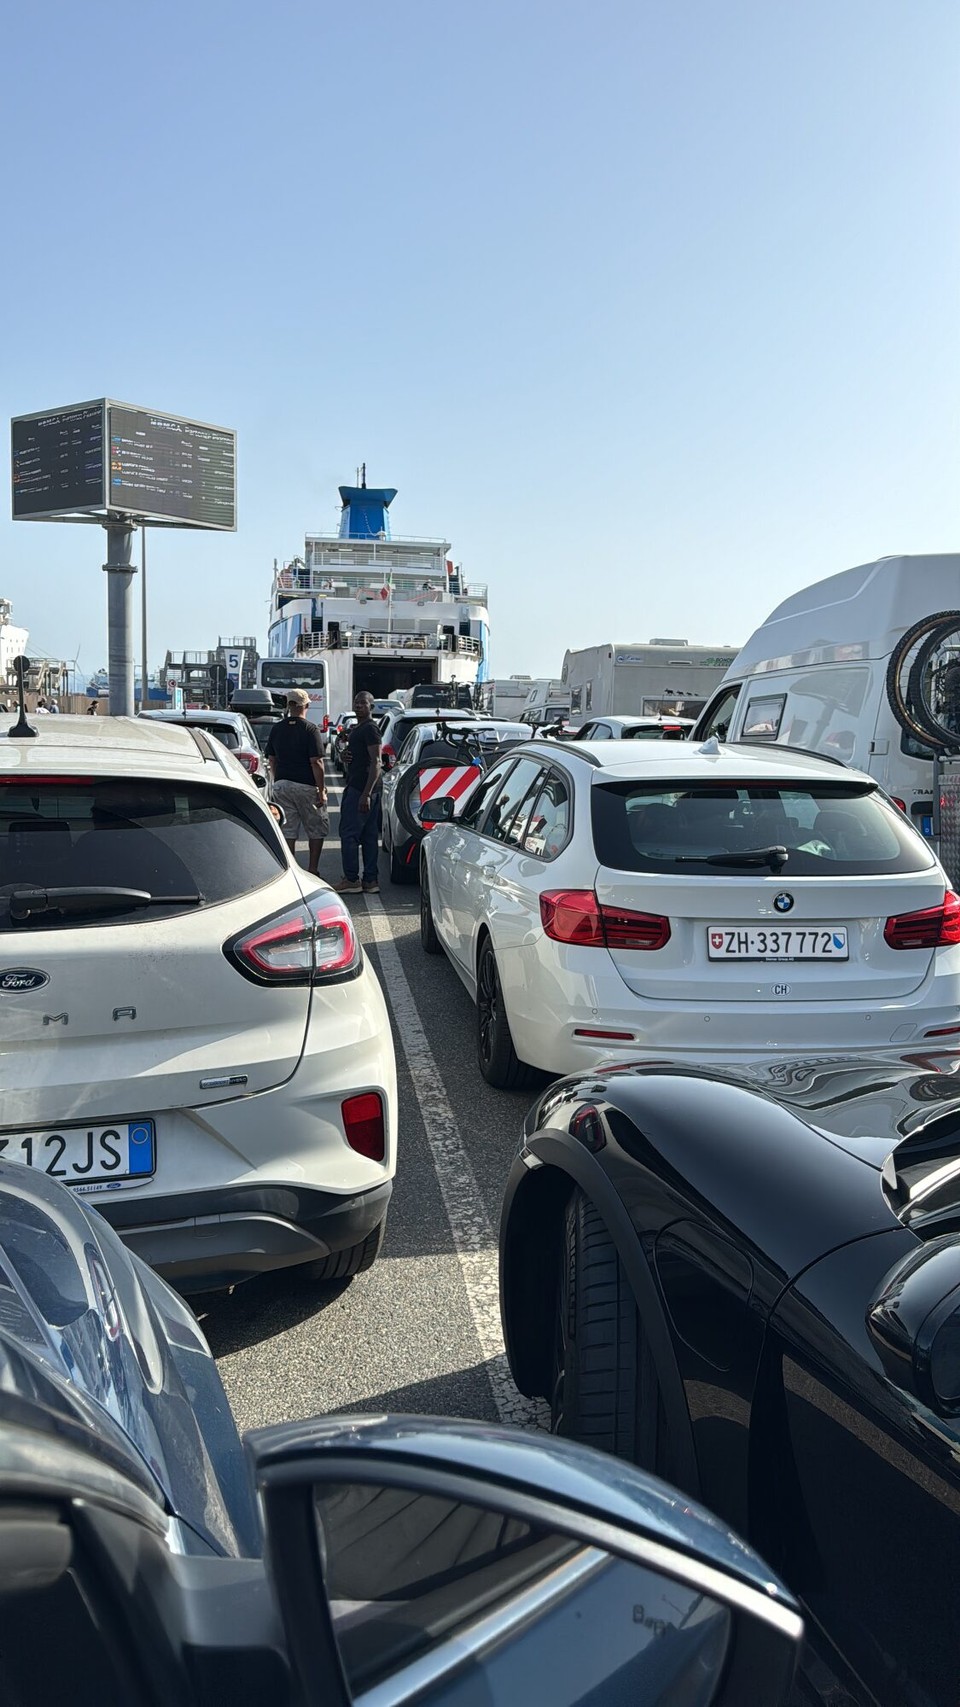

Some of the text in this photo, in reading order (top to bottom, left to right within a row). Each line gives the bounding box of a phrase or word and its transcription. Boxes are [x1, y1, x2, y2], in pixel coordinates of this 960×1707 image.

[229, 654, 239, 668] 5
[2, 973, 36, 988] Ford
[774, 985, 788, 995] CH
